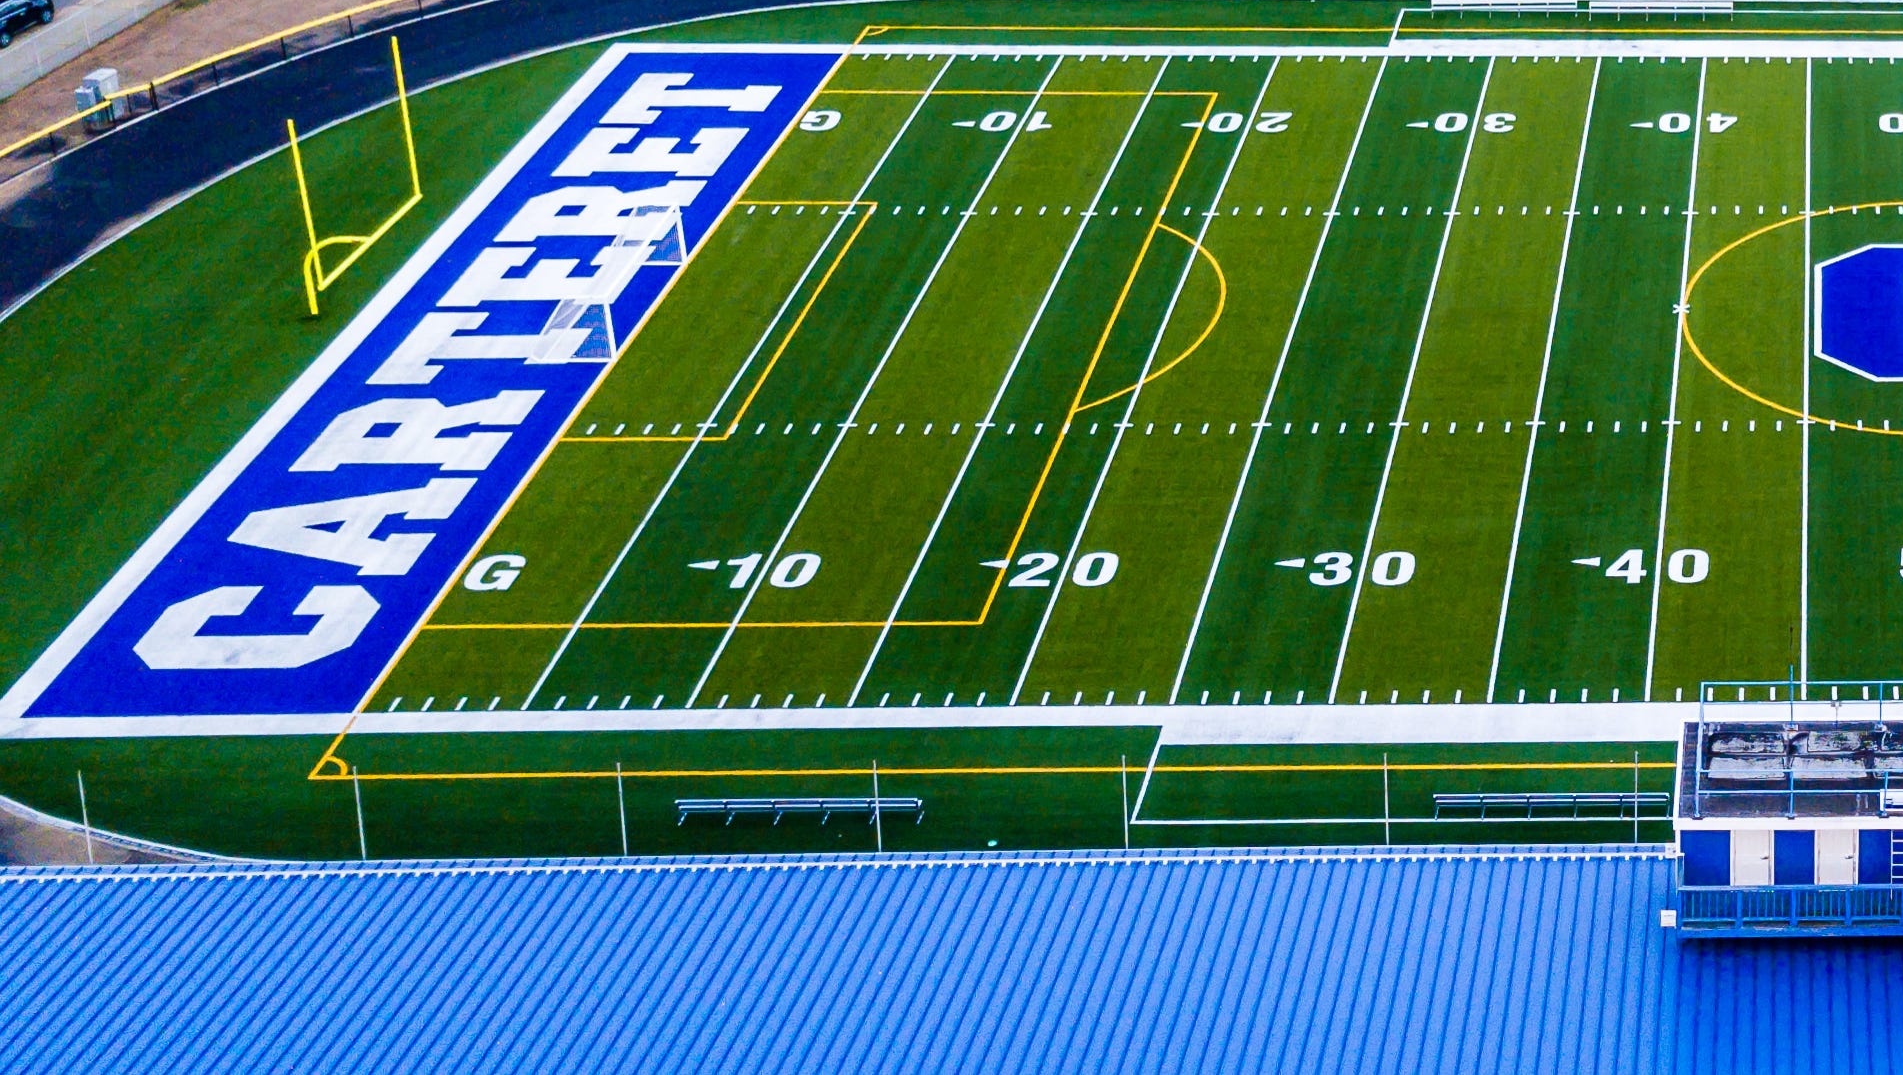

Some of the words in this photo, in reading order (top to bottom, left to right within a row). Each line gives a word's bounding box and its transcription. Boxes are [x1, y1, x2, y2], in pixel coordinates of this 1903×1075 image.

[799, 110, 842, 132] G
[979, 110, 1053, 132] 10
[1207, 111, 1293, 133] 20
[1434, 112, 1517, 133] 30
[1658, 112, 1738, 133] 40
[133, 72, 782, 669] CARTERET
[463, 554, 527, 591] G
[726, 553, 822, 589] 10
[1007, 551, 1120, 587] 20
[1308, 551, 1416, 586] 30
[1605, 548, 1710, 584] 40
